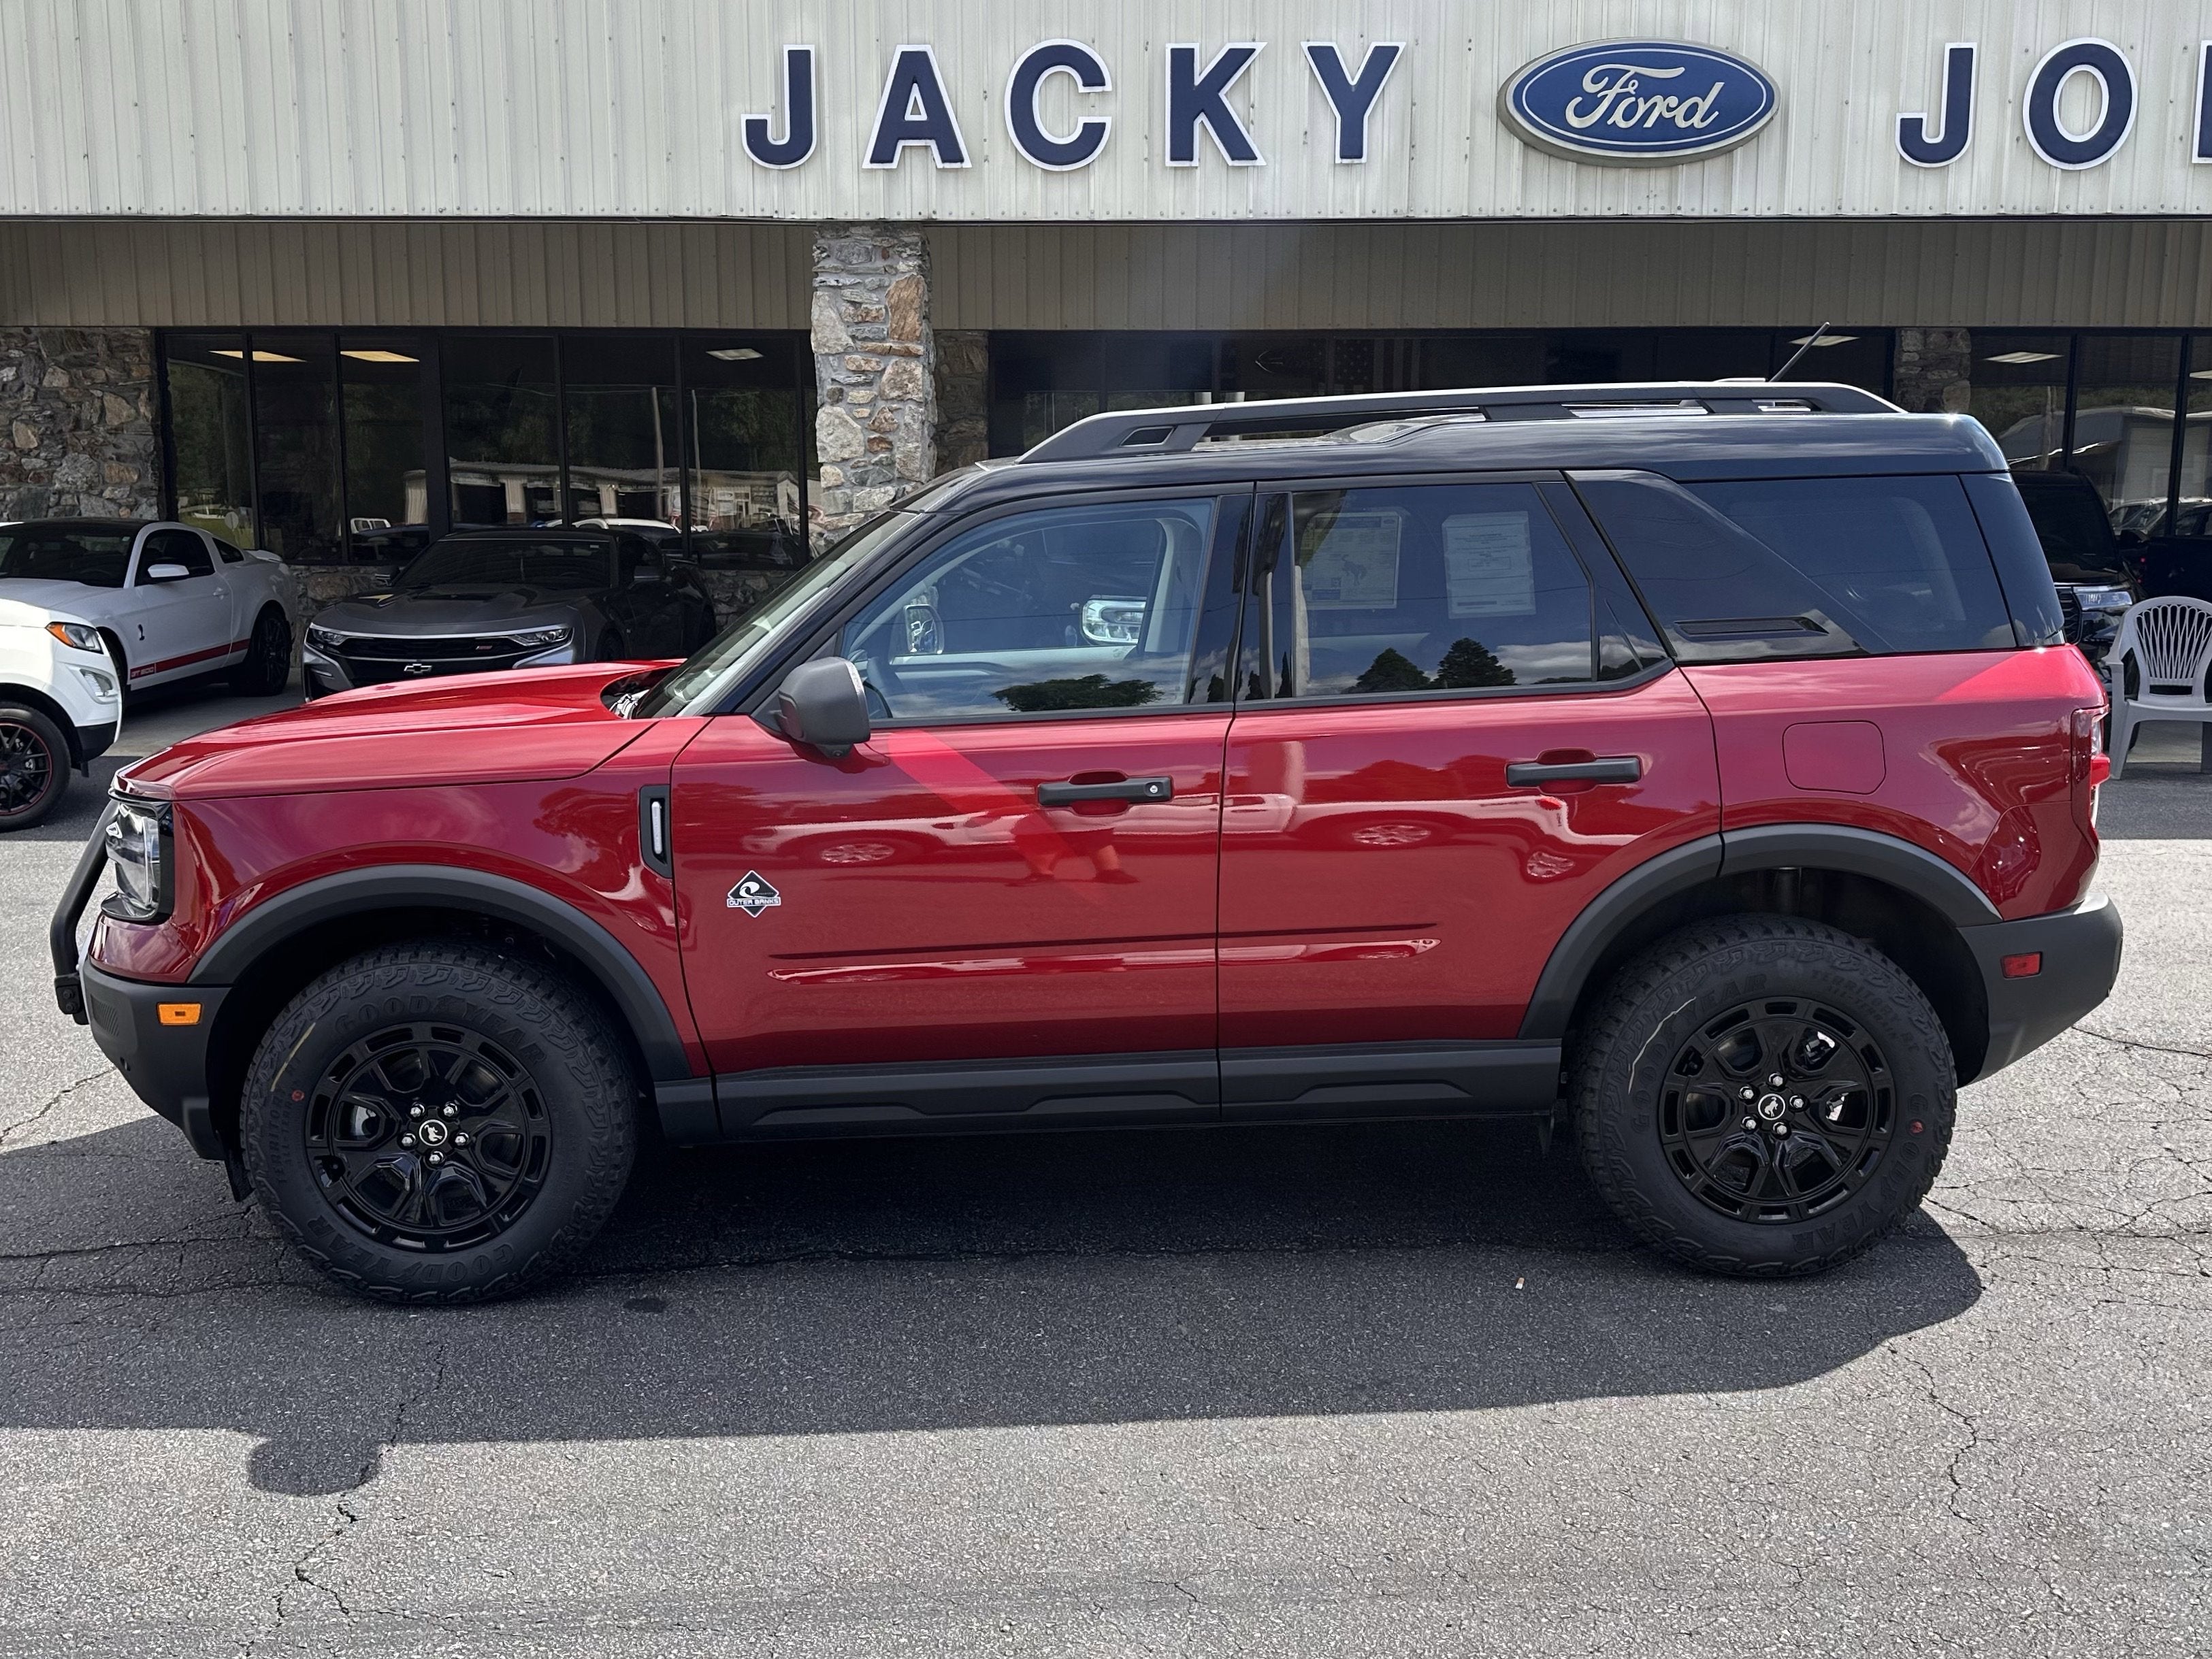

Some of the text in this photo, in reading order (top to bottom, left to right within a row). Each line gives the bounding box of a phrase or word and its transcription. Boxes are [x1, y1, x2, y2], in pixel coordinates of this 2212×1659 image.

[741, 37, 2212, 171] JACKY JO
[1565, 63, 1724, 130] Ford
[334, 994, 549, 1067] GOODYEAR
